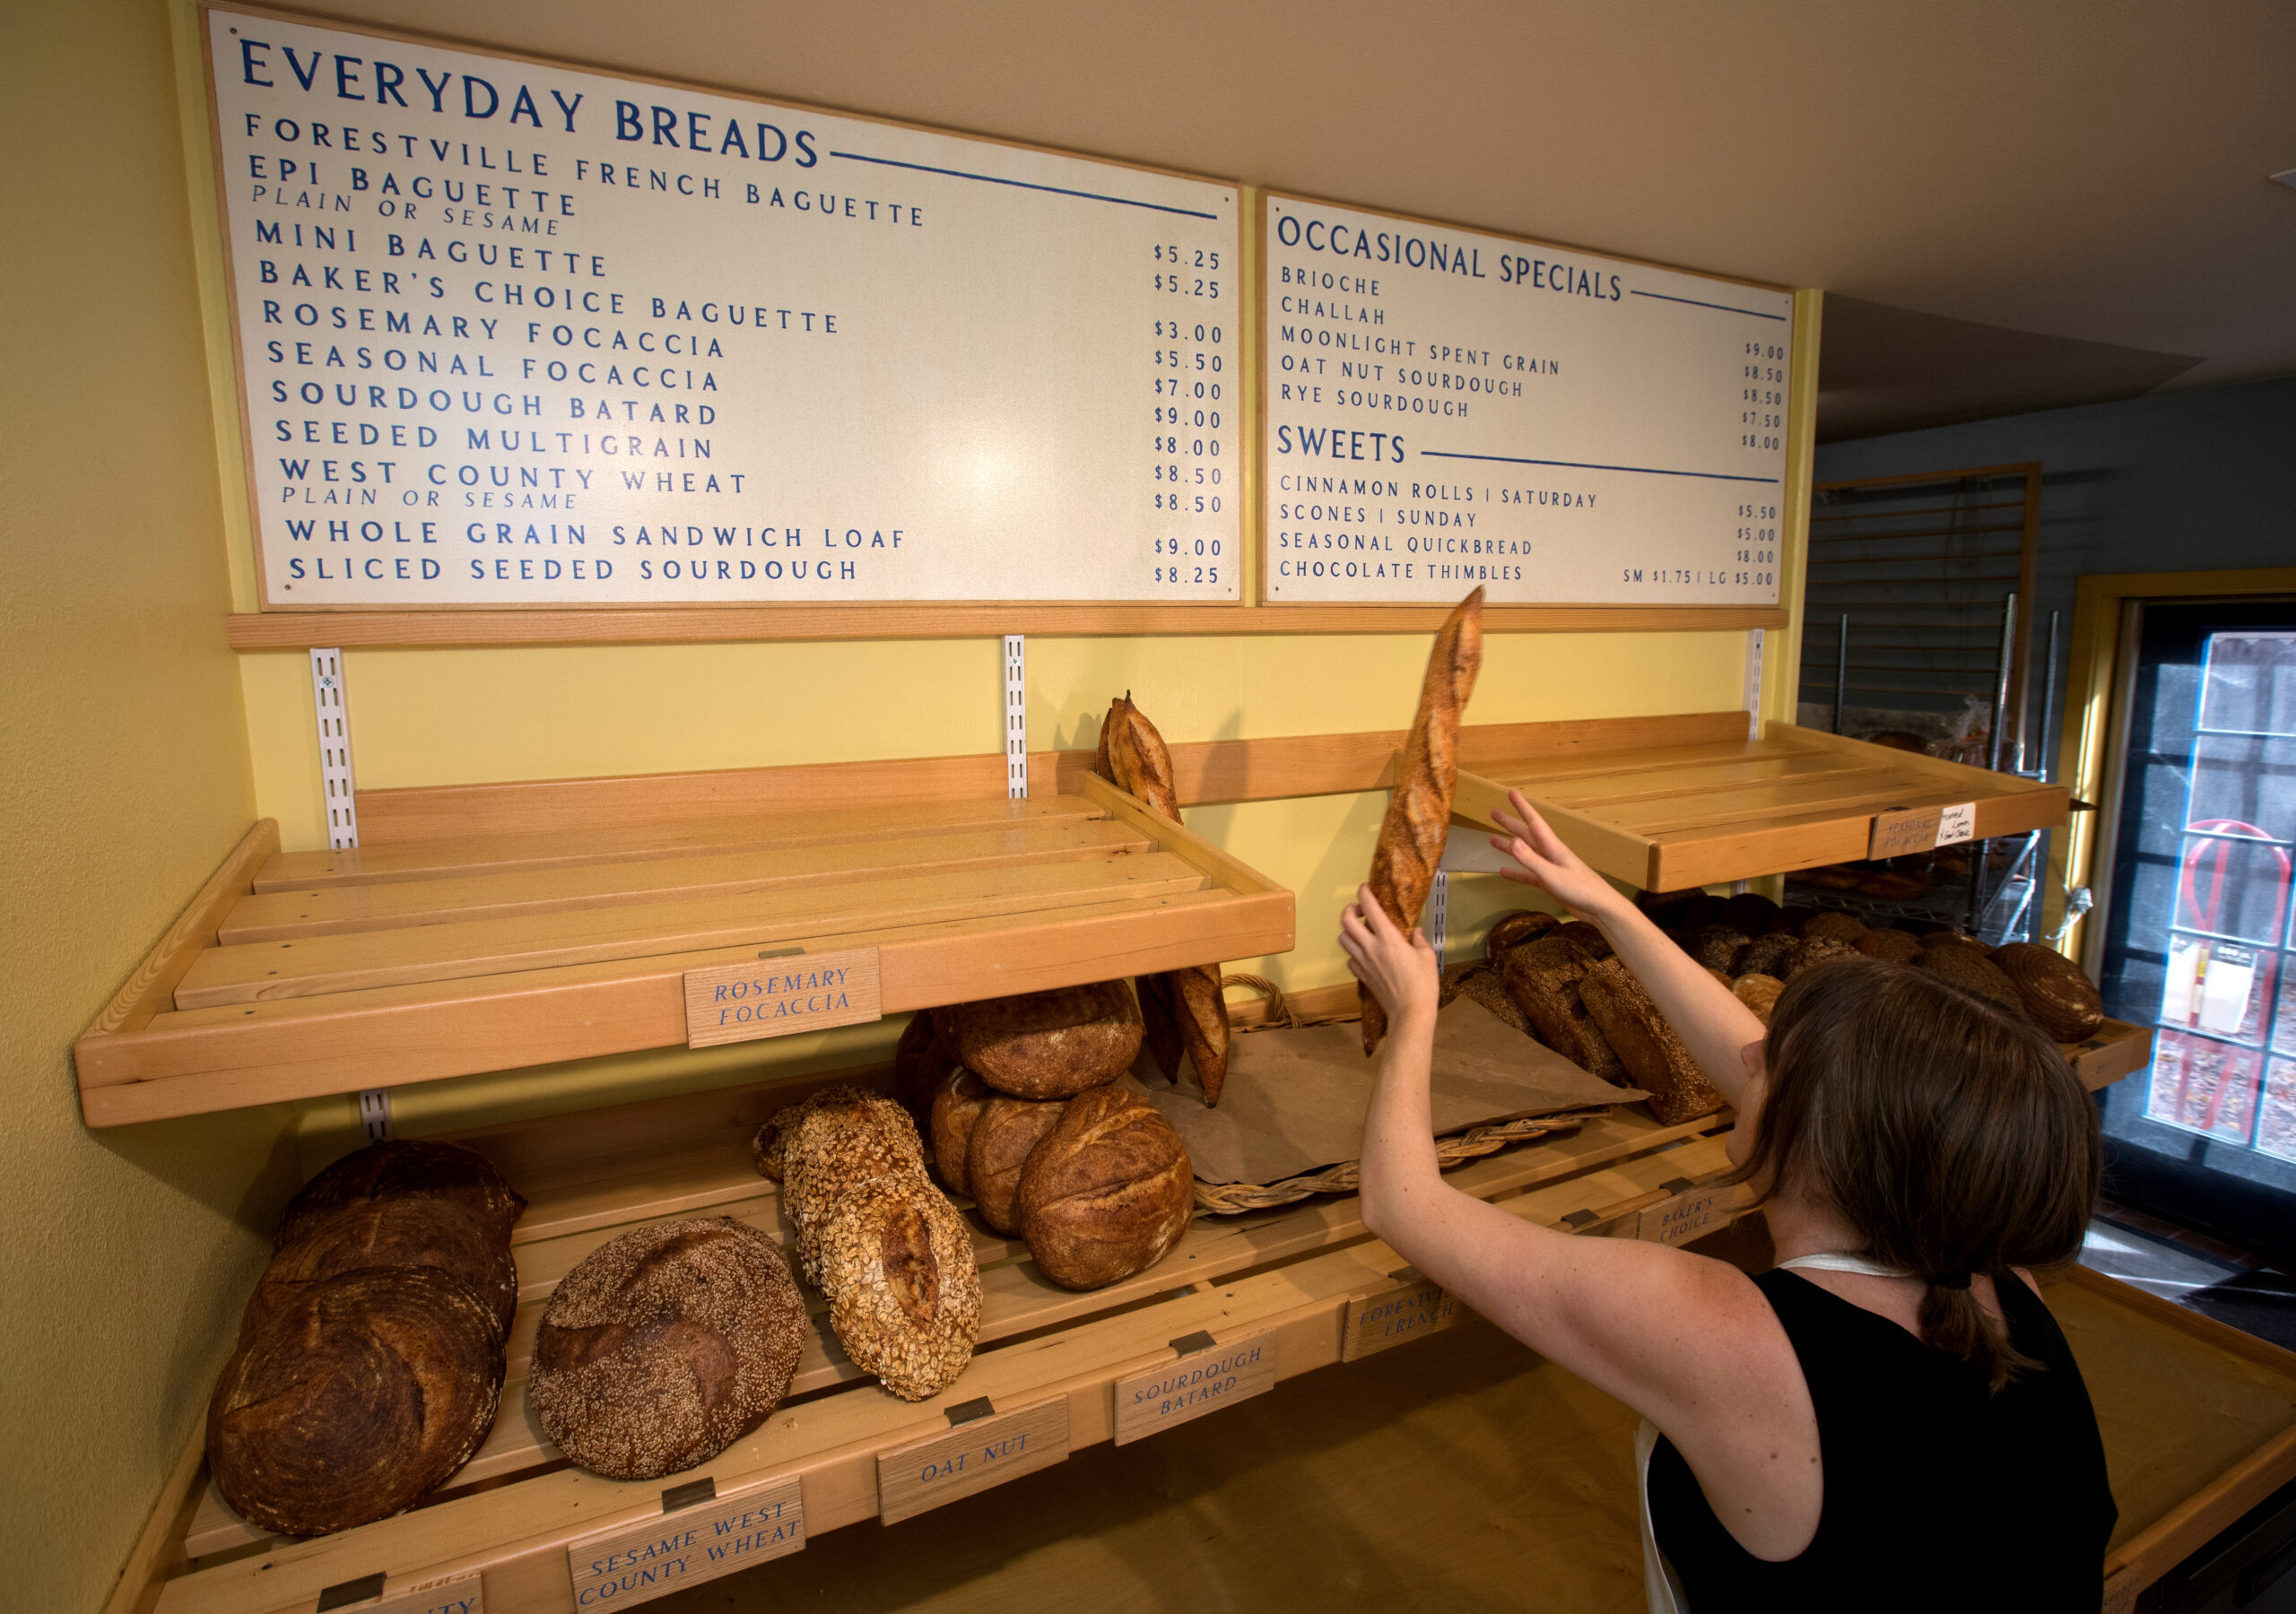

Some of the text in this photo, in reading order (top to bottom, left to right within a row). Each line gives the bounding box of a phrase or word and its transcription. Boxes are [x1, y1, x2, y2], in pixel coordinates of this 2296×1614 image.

[239, 38, 818, 169] EVERYDAY BREADS
[243, 112, 1220, 271] FORESTVILLE FRENCH BAGUETTE $5.25
[251, 184, 559, 236] PLAIN OR SESAME
[248, 153, 1219, 299] EPI BAGUETTE $5.25
[255, 218, 1222, 344] MINI BAGUETTE $3.00
[1277, 215, 1622, 302] OCCASIONAL SPECIALS
[258, 259, 1222, 373] BAKER'S CHOICE BAGUETTE $5.50
[1281, 265, 1784, 361] BRIOCHE $9.00
[1281, 295, 1783, 384] CHALLAH $8.50
[262, 299, 1222, 401] ROSEMARY FOCACCIA $7.00
[1281, 325, 1782, 406] MOONLIGHT SPENT GRAIN $8.50
[266, 340, 1221, 430] SEASONAL FOCACCIA $9.00
[1281, 354, 1780, 429] OAT NUT SOURDOUGH $7.50
[271, 379, 1220, 456] SOURDOUGH BATARD $8.00
[1276, 424, 1405, 464] SWEETS
[1281, 383, 1779, 451] RYE SOURDOUGH $8.00
[274, 419, 1222, 485] SEEDED MULTIGRAIN $8.50
[277, 457, 1222, 513] WEST COUNTY WHEAT $8.50
[282, 486, 576, 509] PLAIN OR SESAME
[1280, 474, 1398, 498] CINNAMON
[1412, 482, 1474, 502] ROLLS
[1501, 488, 1596, 508] SATURDAY
[1738, 504, 1777, 520] $5.50
[284, 518, 1222, 557] WHOLE GRAIN SANDWICH LOAF $9.00
[1280, 503, 1366, 523] SCONES
[1397, 508, 1476, 528] SUNDAY
[1737, 527, 1775, 542] $5.00
[1280, 532, 1774, 564] SEASONAL QUICKBREAD $8.00
[289, 557, 1218, 584] SLICED SEEDED SOURDOUGH $8.25
[1279, 560, 1413, 579] CHOCOLATE
[1427, 564, 1522, 581] THIMBLES
[1622, 568, 1643, 583] SM
[1652, 569, 1692, 585] $1.75
[1709, 570, 1727, 586] LG
[1735, 571, 1774, 586] $5.00
[715, 968, 849, 1002] ROSEMARY
[720, 992, 848, 1025] FOCACCIA
[1659, 1212, 1709, 1243] CHOICE
[1662, 1196, 1713, 1227] BAKER'S
[1360, 1287, 1451, 1326] FORESTVI
[1385, 1301, 1453, 1337] FRENCH
[1134, 1347, 1262, 1405] SOURDOUGH
[1161, 1376, 1237, 1415] BATARD
[921, 1433, 1031, 1482] OAT NUT
[578, 1520, 801, 1606] COUNTY WHEAT
[591, 1501, 787, 1577] SESAME WEST
